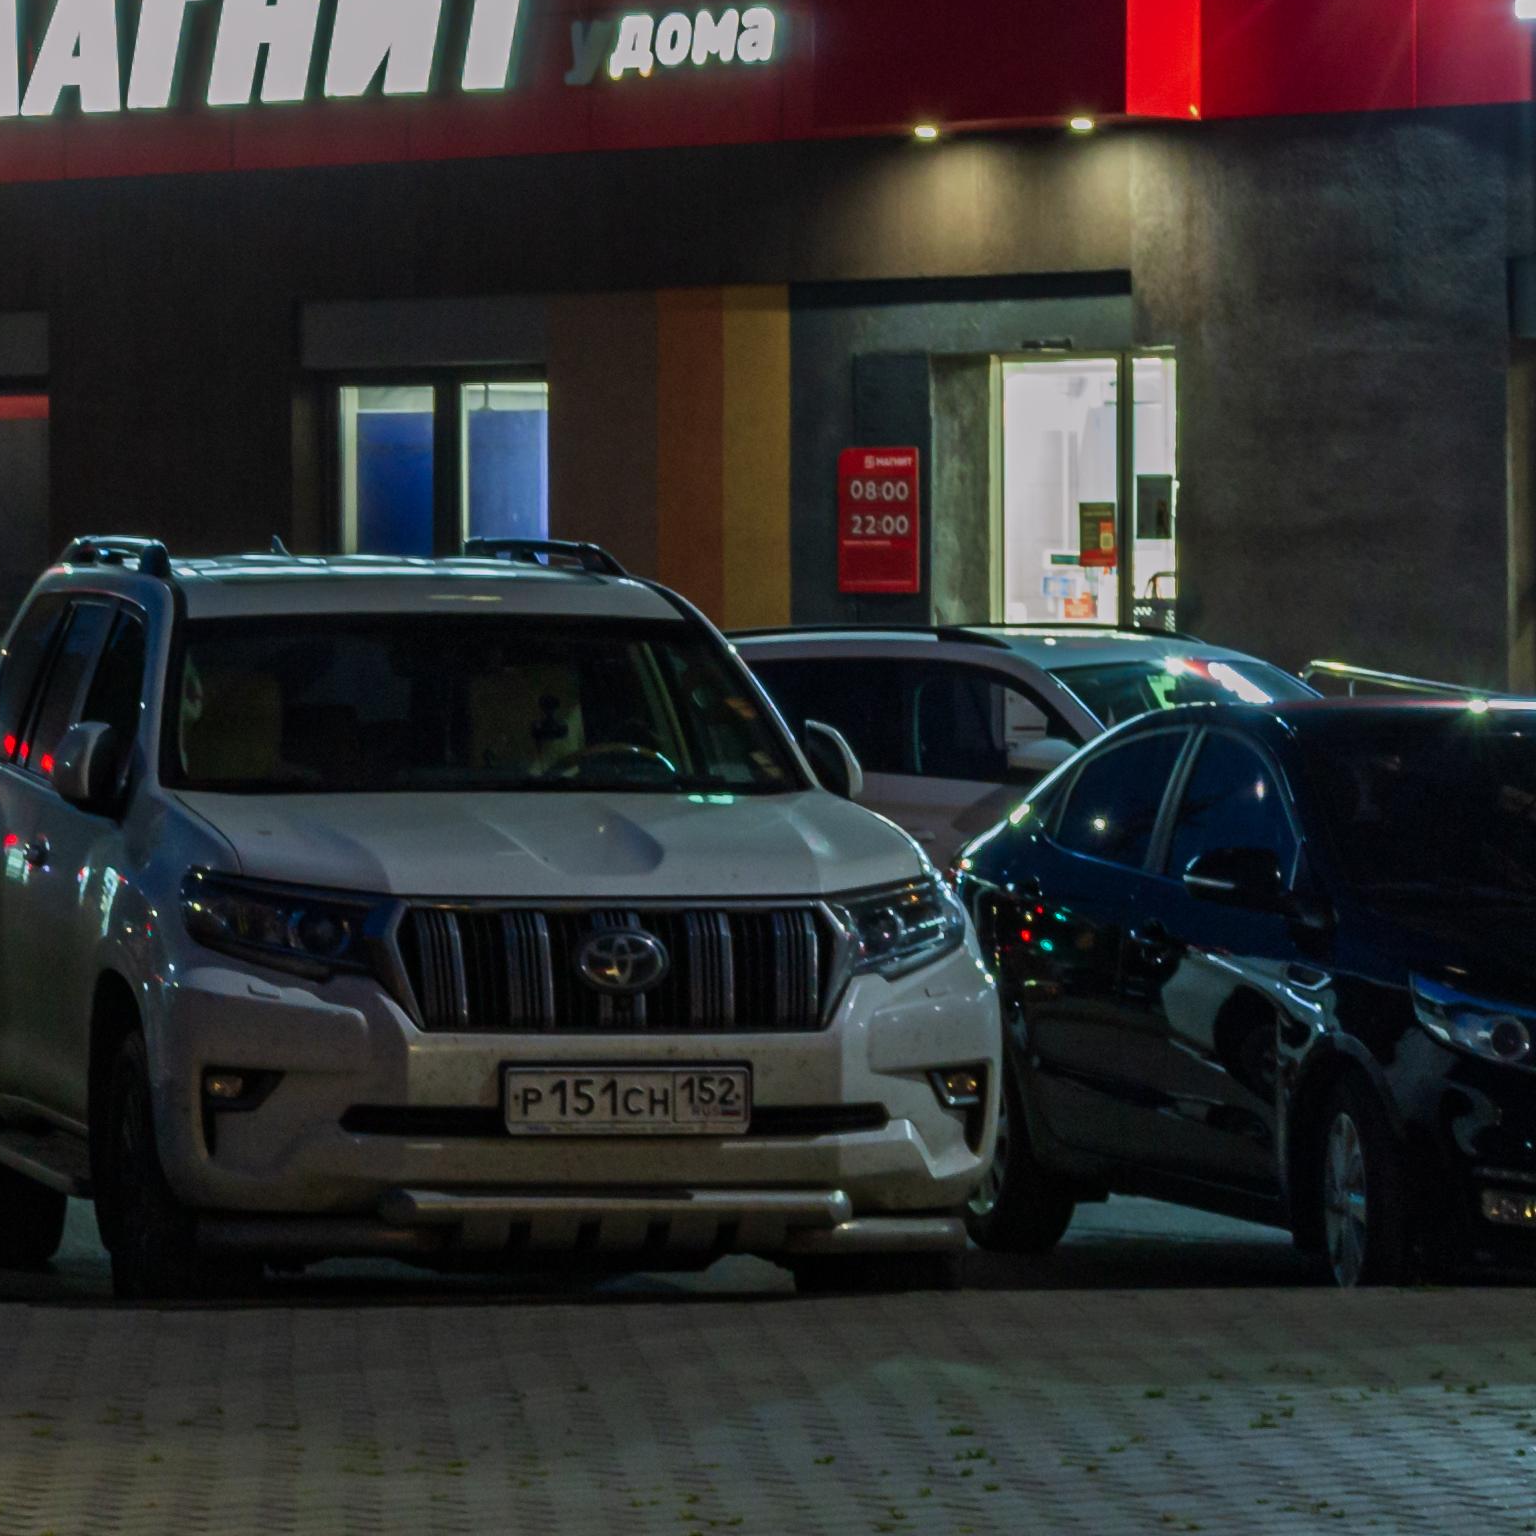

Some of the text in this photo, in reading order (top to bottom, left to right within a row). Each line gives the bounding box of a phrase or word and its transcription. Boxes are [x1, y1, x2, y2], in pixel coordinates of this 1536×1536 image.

[564, 20, 613, 86] у
[609, 7, 776, 80] дома
[850, 479, 909, 501] 08:00
[851, 514, 909, 535] 22:00
[521, 1076, 736, 1116] Р151СН 152
